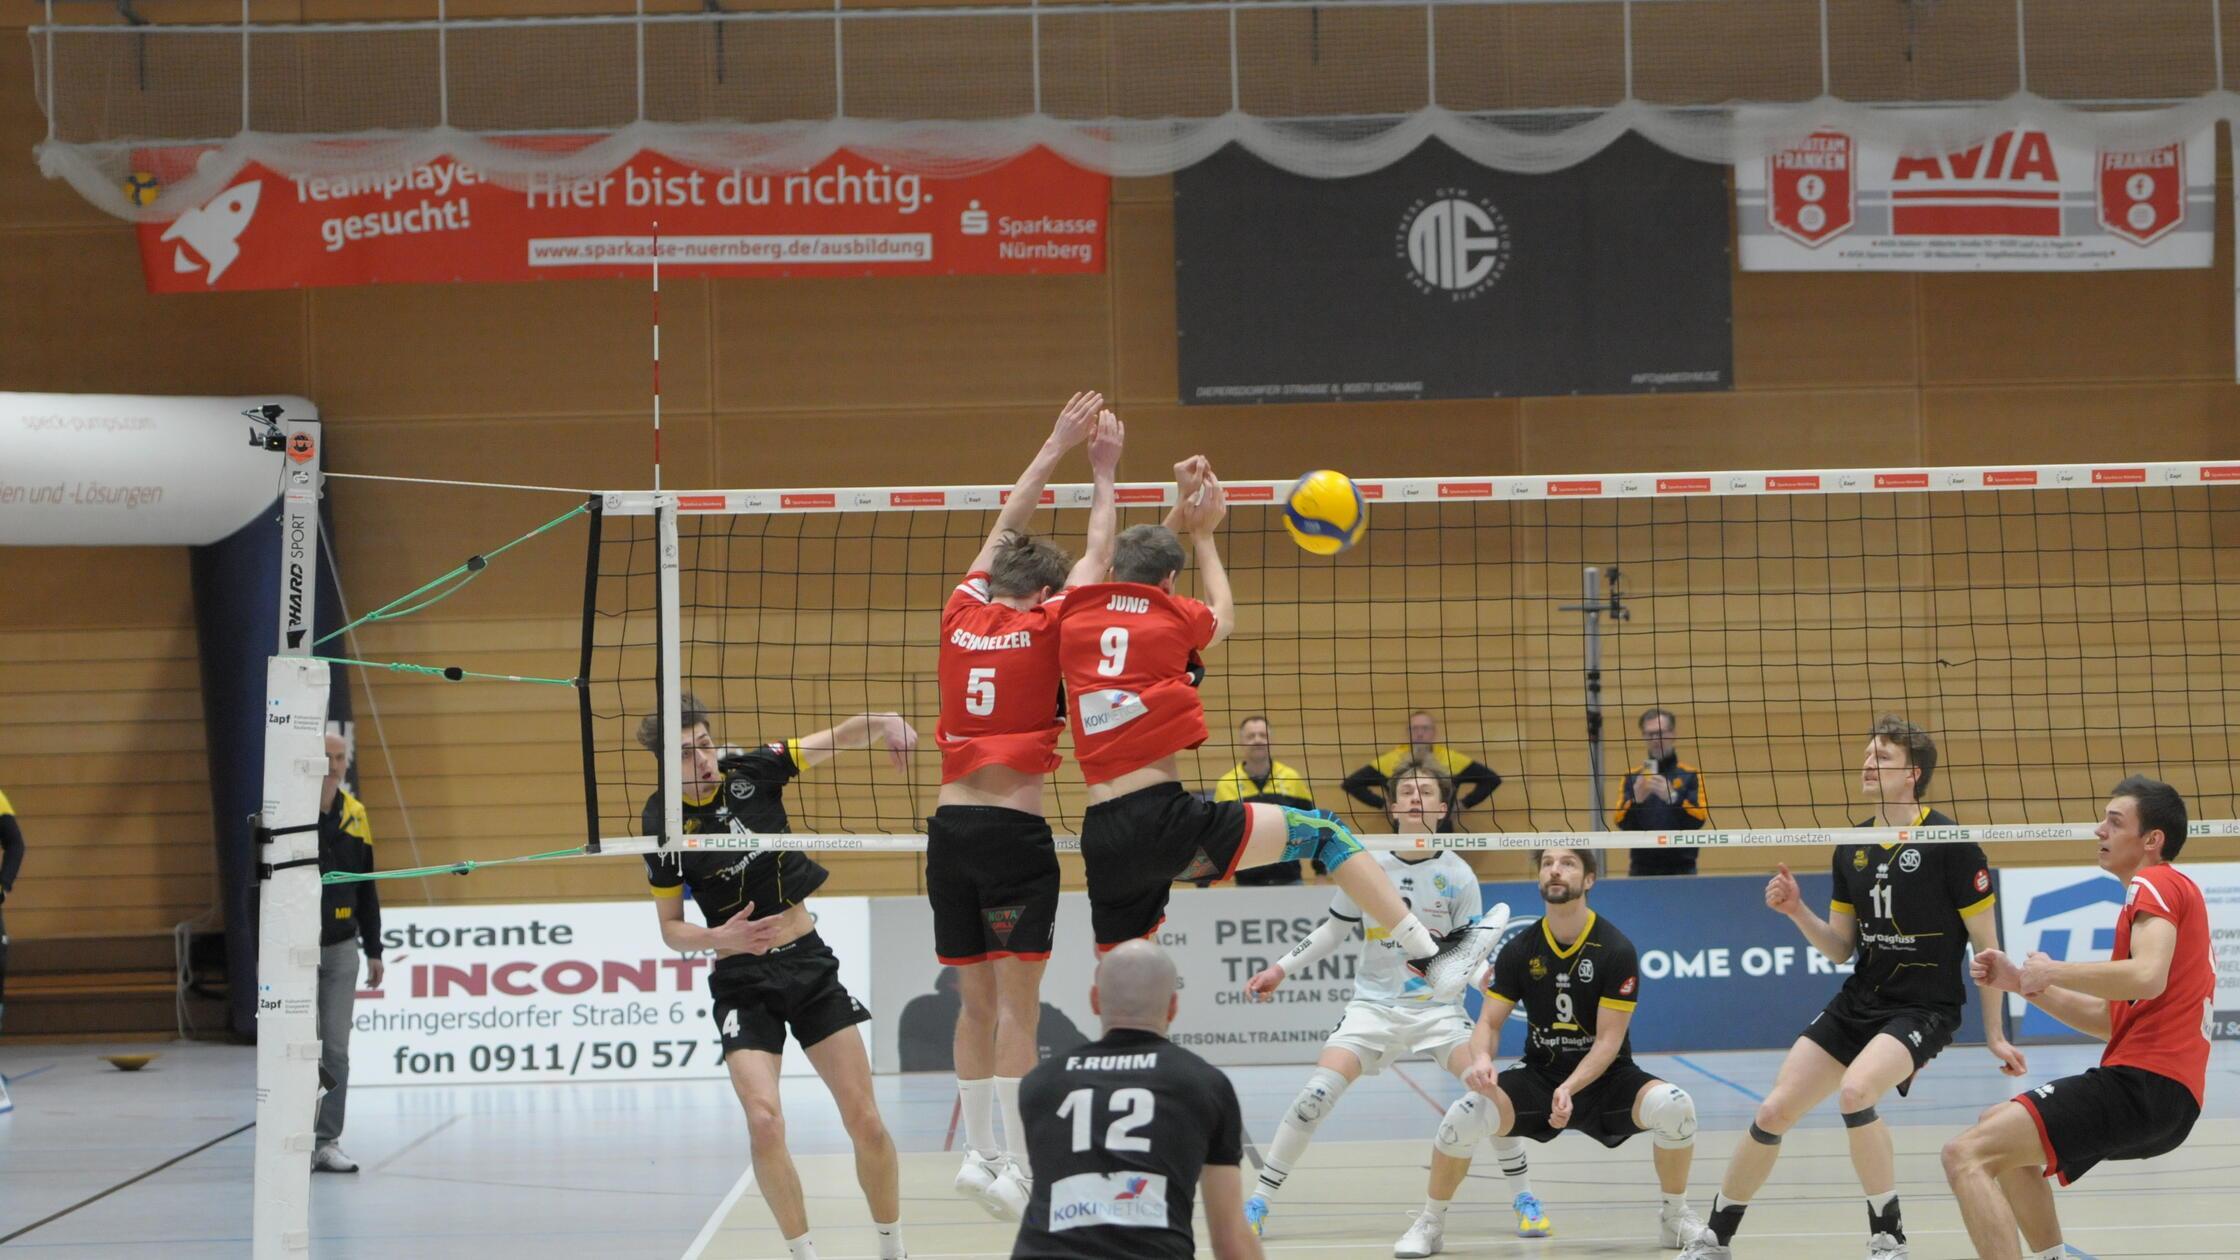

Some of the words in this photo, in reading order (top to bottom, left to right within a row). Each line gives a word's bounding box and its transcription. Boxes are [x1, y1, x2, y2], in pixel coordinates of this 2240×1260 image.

[1776, 152, 1845, 170] FRANKEN
[527, 173, 614, 208] Hier
[626, 166, 706, 207] bist
[716, 169, 770, 205] du
[784, 165, 933, 213] richtig.
[321, 198, 471, 252] gesucht!
[998, 216, 1097, 237] Sparkasse
[1000, 240, 1092, 262] Nürnberg
[29, 481, 65, 504] und
[69, 481, 164, 510] -Lösungen
[291, 513, 305, 559] SPORT
[1106, 594, 1150, 614] JUNG
[950, 628, 1031, 651] SCHMELZER
[1097, 627, 1129, 677] 9
[966, 668, 996, 716] 5
[268, 713, 291, 726] Zapf
[704, 838, 760, 848] FUCHS
[771, 837, 802, 848] Ideen
[806, 838, 862, 848] umsetzen
[1431, 837, 1488, 848] FUCHS
[1499, 836, 1531, 848] Ideen
[1533, 836, 1590, 848] umsetzen
[1674, 834, 1729, 845] FUCHS
[1740, 832, 1771, 843] Ideen
[1775, 832, 1831, 843] umsetzen
[1915, 829, 1970, 840] FUCHS
[1981, 828, 2012, 839] Ideen
[2015, 827, 2072, 838] umsetzen
[1869, 884, 1892, 919] 11
[383, 920, 573, 949] storante
[1640, 948, 1731, 980] OME
[1741, 947, 1794, 977] OF
[260, 998, 282, 1010] Zapf
[1556, 993, 1573, 1023] 9
[350, 1003, 562, 1036] ehringersdorfer
[572, 1002, 658, 1026] Straße
[669, 1002, 684, 1024] 6
[722, 1009, 741, 1038] 4
[652, 1040, 697, 1068] 57
[1065, 1053, 1157, 1070] F.RUHM
[1056, 1087, 1155, 1152] 12
[1053, 1200, 1165, 1222] KOKINETICS
